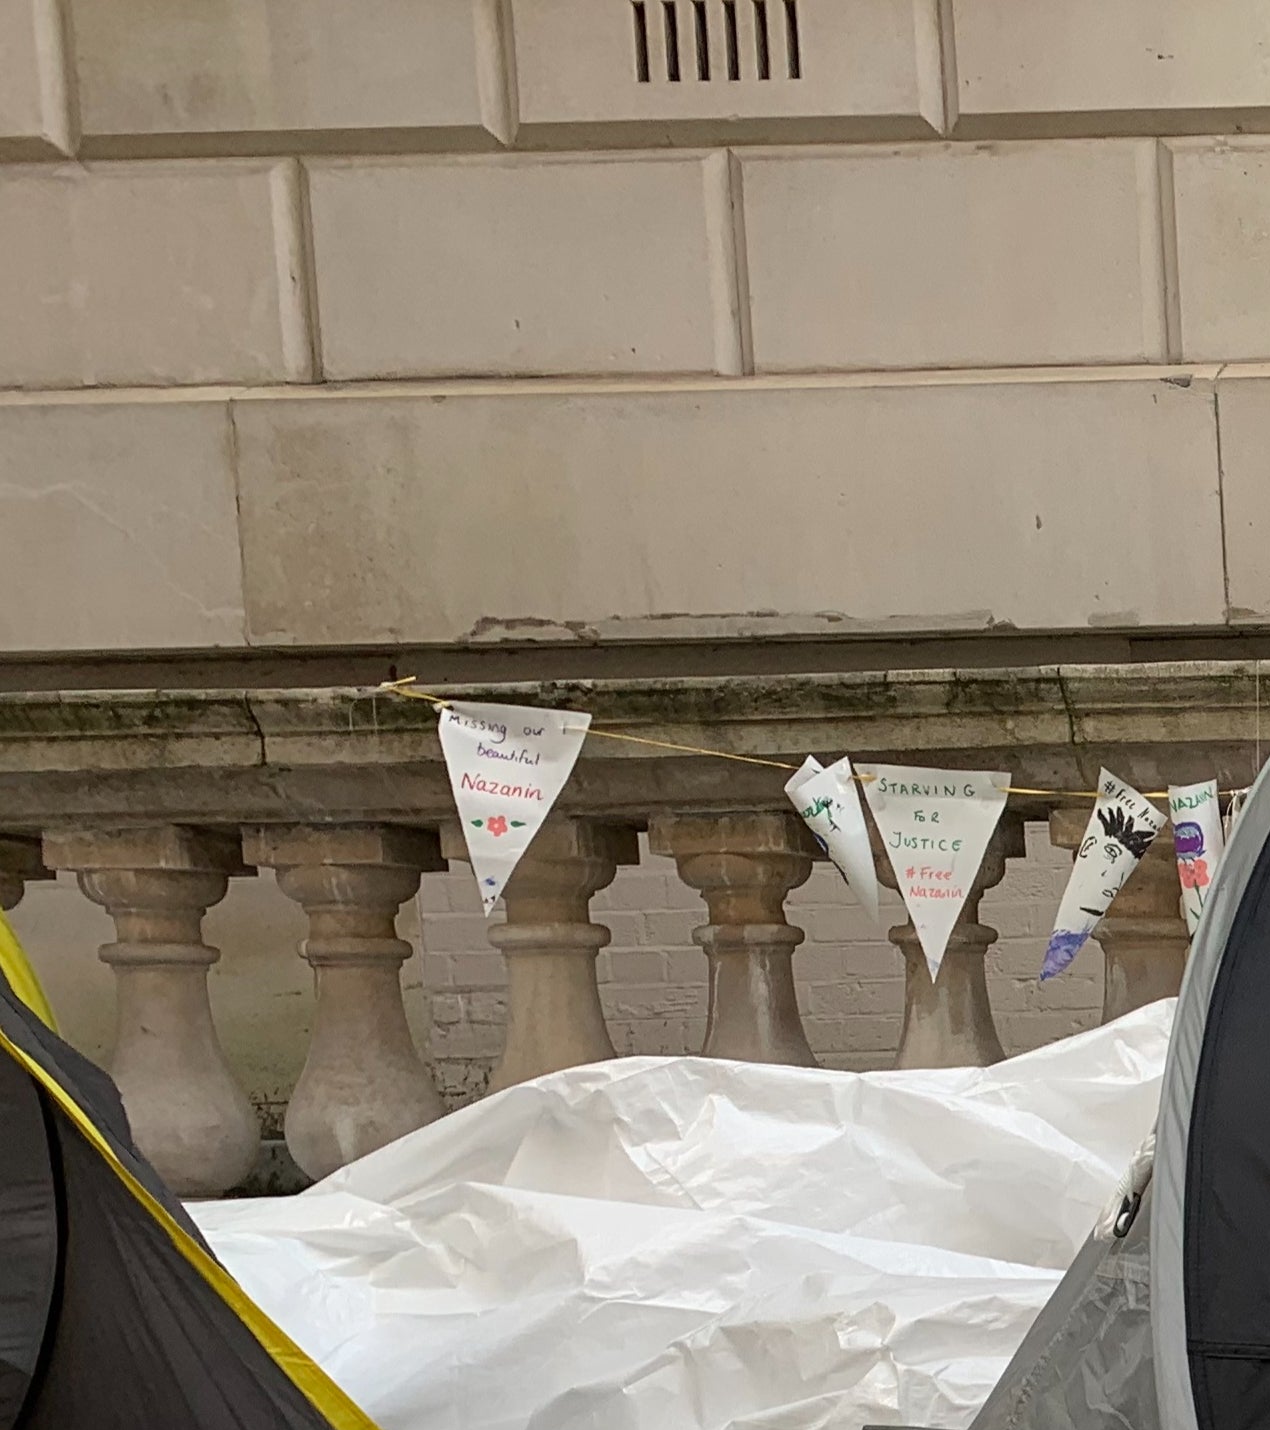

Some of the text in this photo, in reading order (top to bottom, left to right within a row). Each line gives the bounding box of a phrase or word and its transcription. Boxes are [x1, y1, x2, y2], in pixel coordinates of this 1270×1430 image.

[449, 704, 544, 744] Missing our
[477, 743, 540, 766] beautiful
[461, 773, 543, 800] Nazanin
[878, 778, 976, 798] STARVING
[914, 811, 940, 824] FOR
[889, 831, 963, 850] JUSTICE
